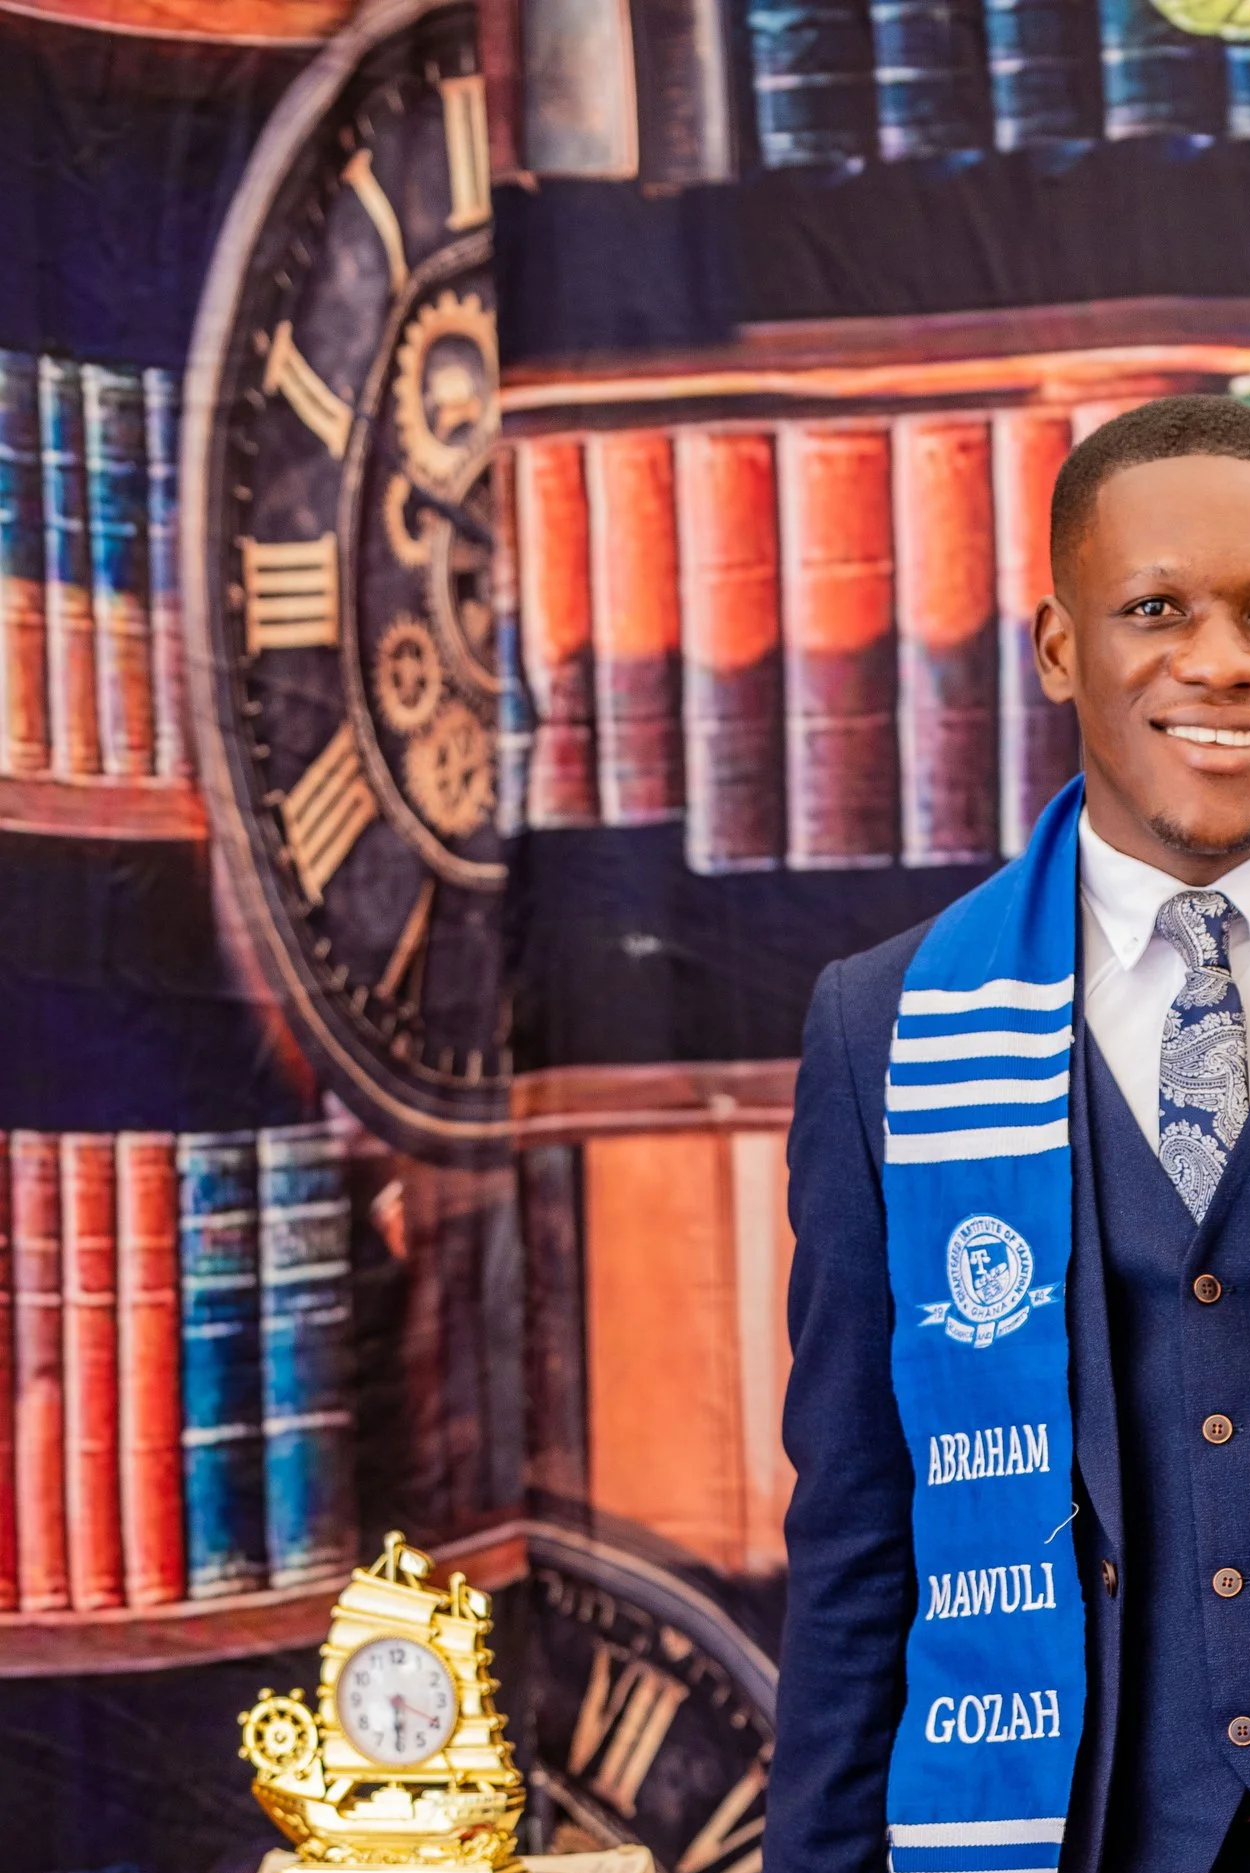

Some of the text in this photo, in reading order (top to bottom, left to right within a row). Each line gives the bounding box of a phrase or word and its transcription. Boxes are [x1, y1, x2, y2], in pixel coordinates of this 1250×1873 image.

[959, 1220, 1001, 1241] INSTITUTE
[1004, 1230, 1016, 1242] OF
[971, 1303, 1008, 1318] GHANA
[928, 1423, 1050, 1486] ABRAHAM
[926, 1562, 1057, 1620] MAWULI
[389, 1648, 406, 1665] 12
[356, 1671, 370, 1687] 10
[430, 1671, 440, 1688] 2
[437, 1692, 447, 1708] 3
[925, 1690, 1060, 1744] GOZAH
